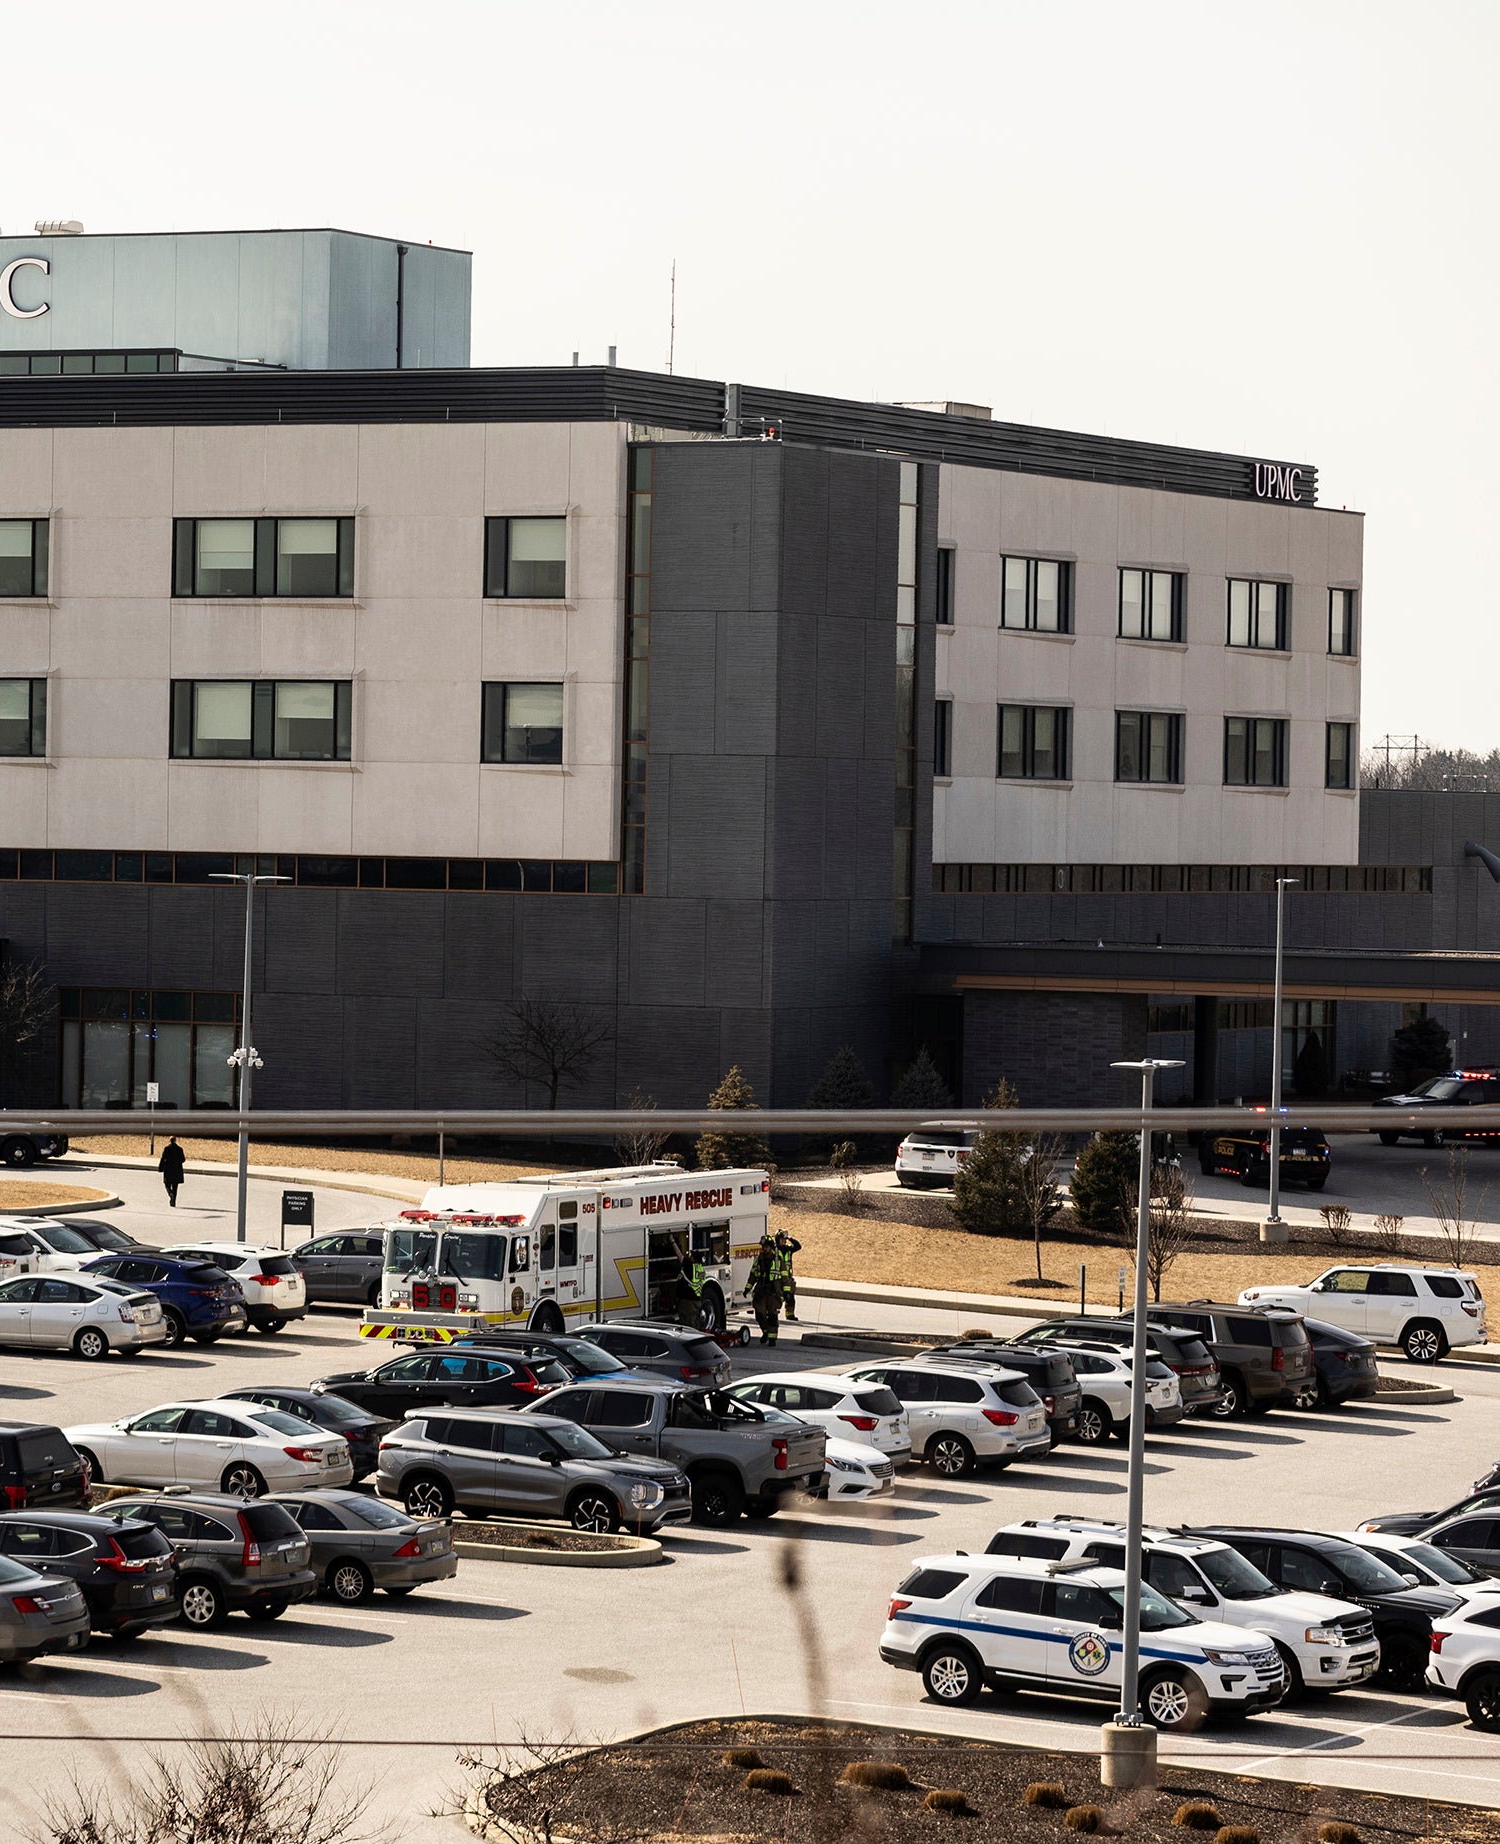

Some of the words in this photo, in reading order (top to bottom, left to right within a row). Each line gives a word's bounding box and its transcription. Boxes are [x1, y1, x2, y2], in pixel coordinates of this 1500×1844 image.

[1254, 463, 1302, 502] UPMC
[582, 1203, 595, 1214] 505
[640, 1192, 683, 1215] HEAVY
[685, 1188, 733, 1211] RESCUE
[735, 1247, 761, 1259] RESCU
